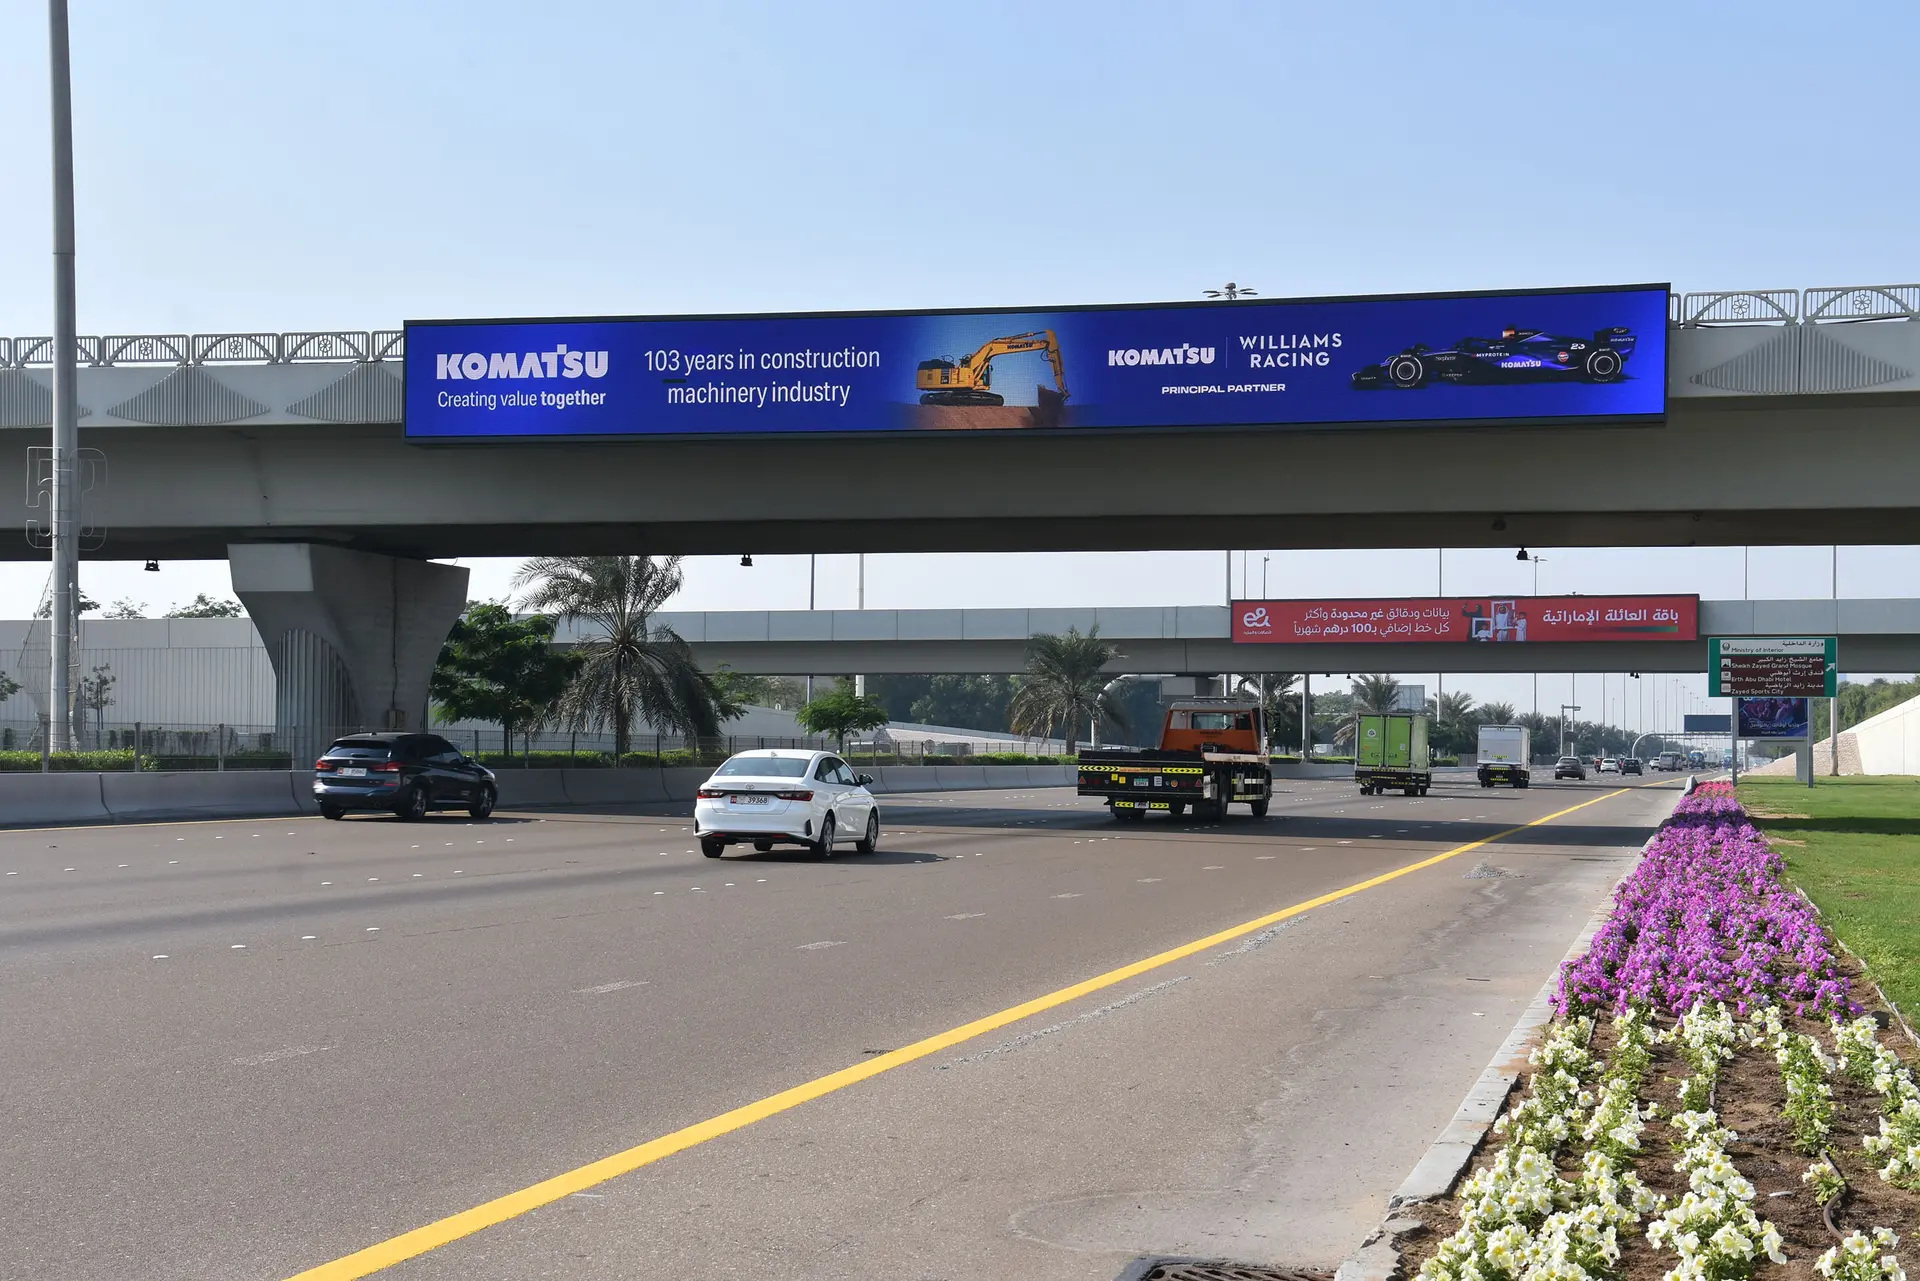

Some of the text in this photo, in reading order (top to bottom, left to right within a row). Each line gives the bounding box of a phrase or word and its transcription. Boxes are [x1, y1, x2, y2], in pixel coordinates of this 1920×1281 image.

[1240, 333, 1343, 351] WILLIAMS
[436, 343, 609, 380] KOMATSU
[645, 347, 881, 376] 103 years in construction
[1108, 342, 1215, 367] KOMATSU
[1250, 351, 1331, 368] RACING
[1501, 359, 1542, 369] KOMATSU
[667, 382, 850, 409] machinery industry
[1162, 383, 1286, 396] PRINCIPAL PARTNER
[437, 390, 607, 411] Creating value together
[1304, 608, 1450, 621] بيانات ودقائق غير محدودة وأكثر
[1543, 609, 1679, 626] باقة العائلة الإماراتية
[1323, 623, 1348, 635] درهم
[1379, 622, 1412, 637] إضافي
[1414, 622, 1432, 634] خط
[1435, 622, 1450, 634] كل
[747, 796, 768, 804] 39368
